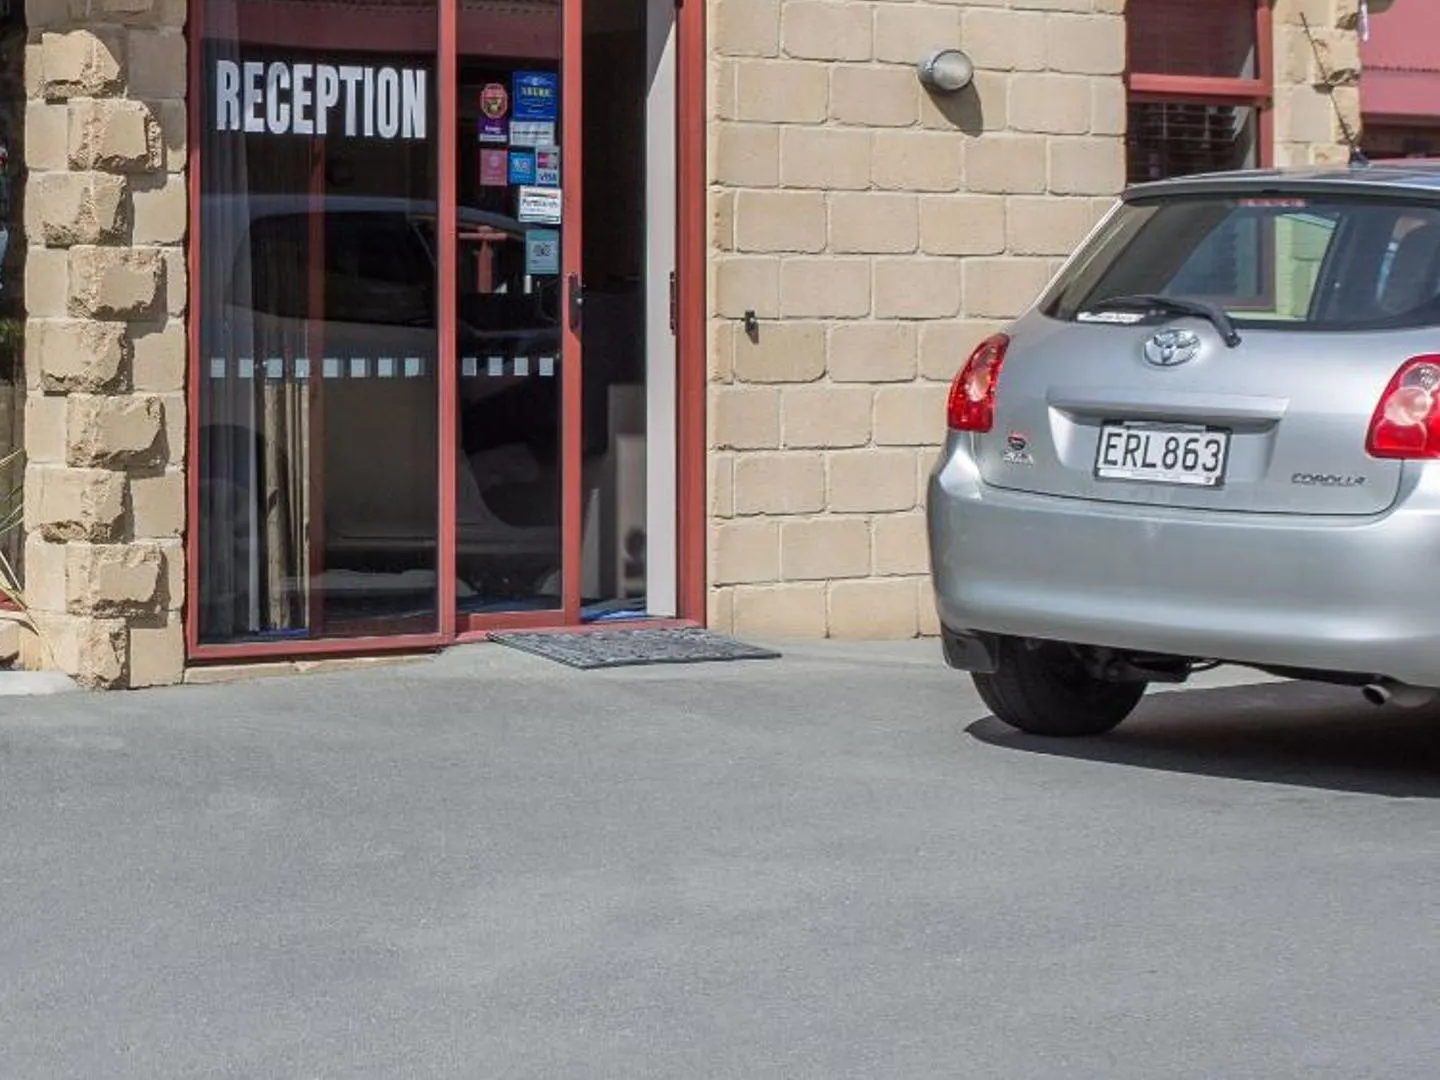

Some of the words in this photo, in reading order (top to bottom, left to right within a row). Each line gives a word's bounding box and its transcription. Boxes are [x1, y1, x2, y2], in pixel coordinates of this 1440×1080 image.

[216, 60, 427, 139] RECEPTION
[1103, 433, 1221, 471] ERL863
[1291, 472, 1366, 488] COROLLA
